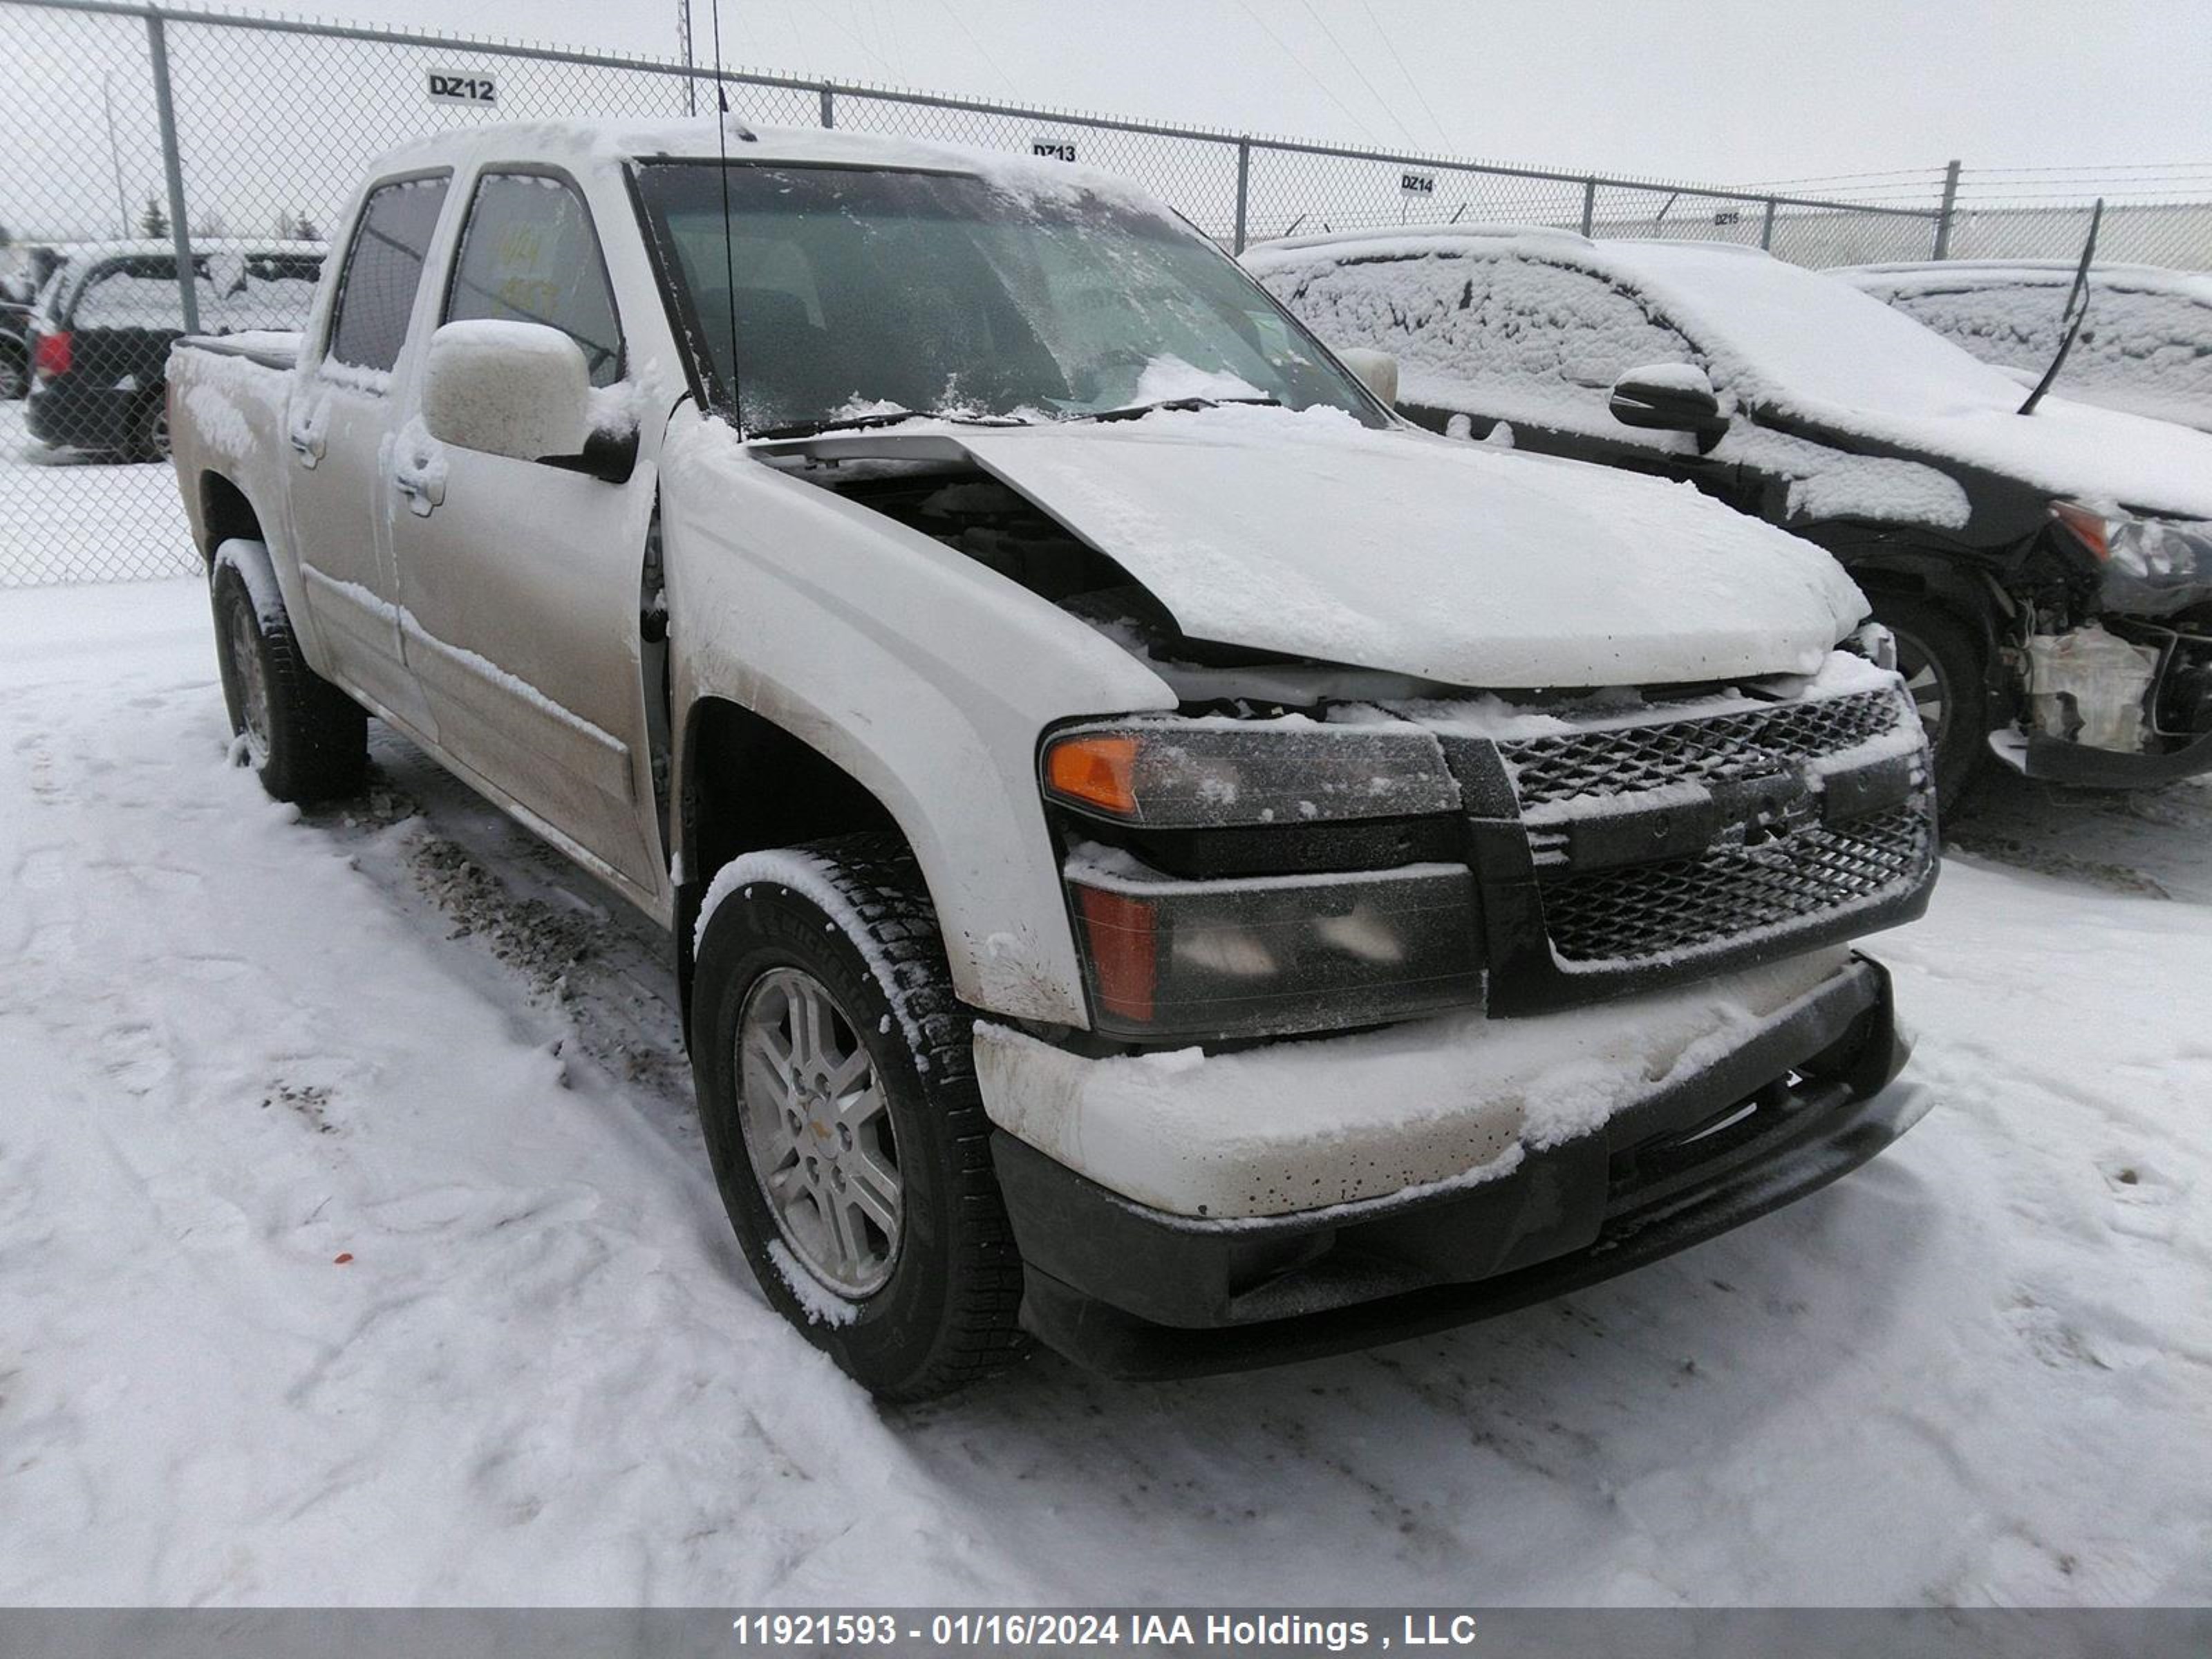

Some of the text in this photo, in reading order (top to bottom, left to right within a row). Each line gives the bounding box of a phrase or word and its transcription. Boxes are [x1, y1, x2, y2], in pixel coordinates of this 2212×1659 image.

[430, 75, 494, 101] DZ12
[1402, 175, 1433, 193] DZ14
[1715, 212, 1739, 225] DZ15
